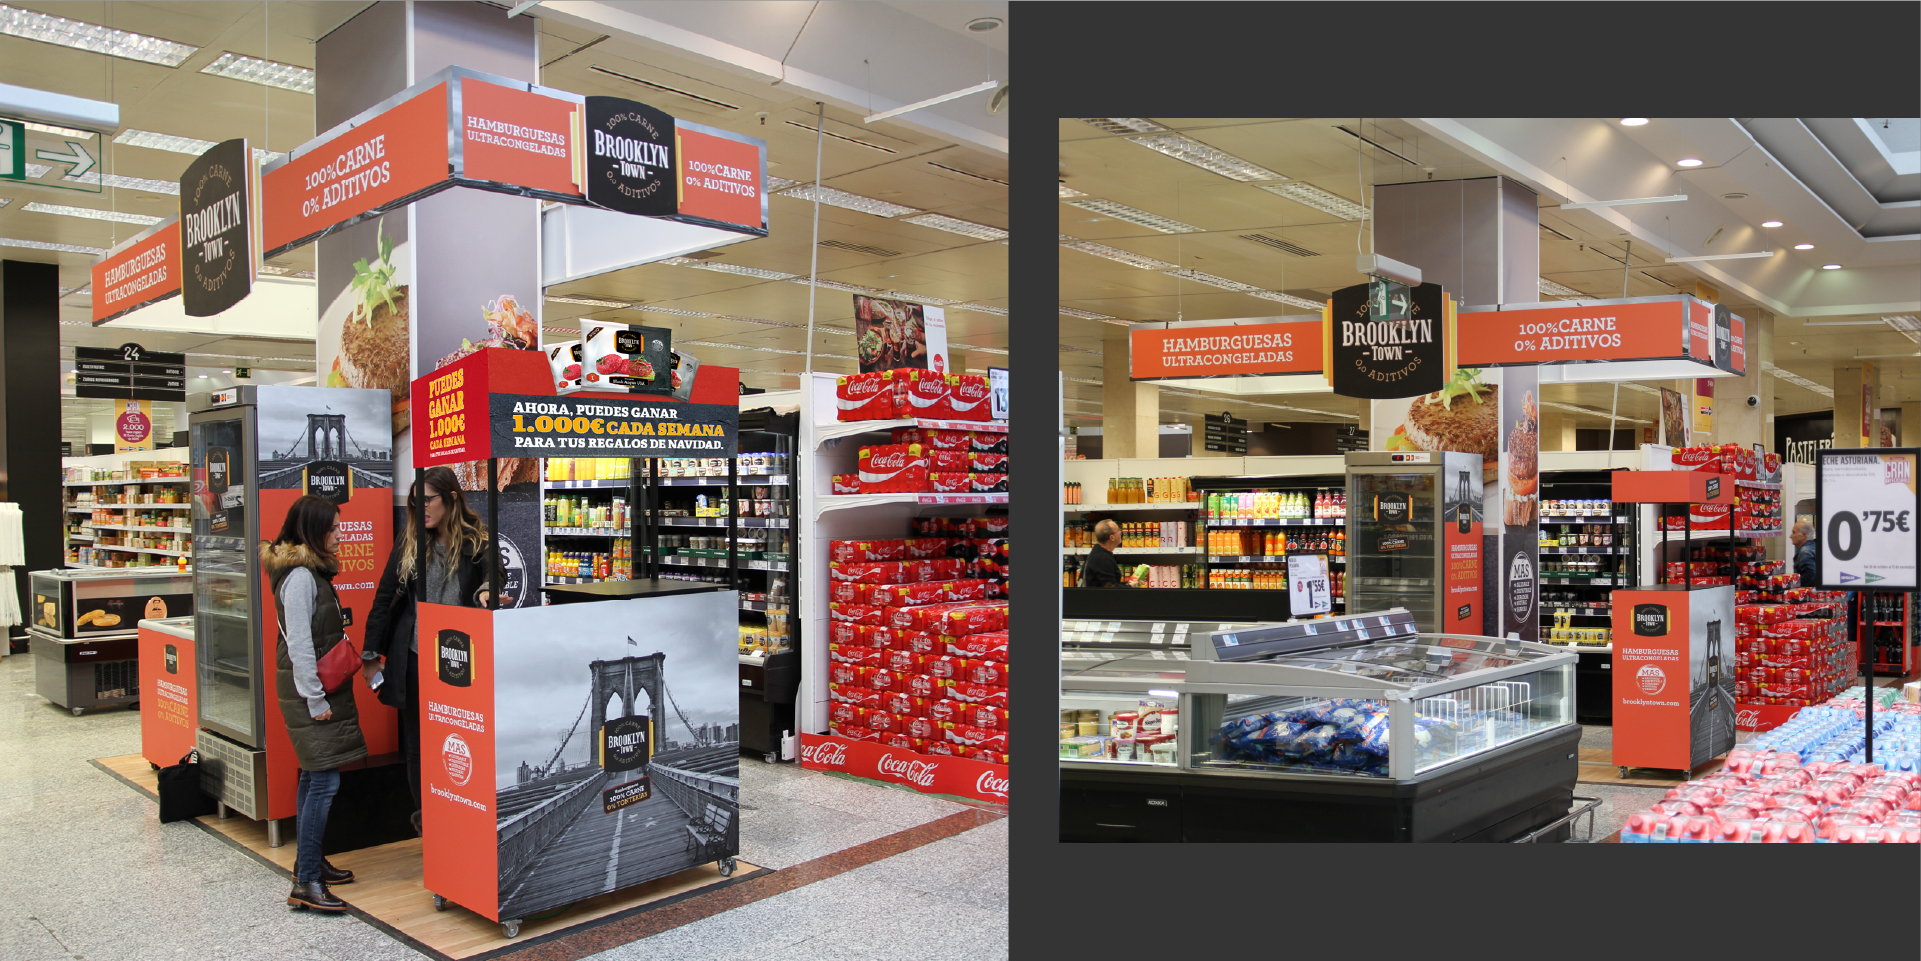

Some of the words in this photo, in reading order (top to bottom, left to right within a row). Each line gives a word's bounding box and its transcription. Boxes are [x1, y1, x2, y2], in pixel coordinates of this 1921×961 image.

[467, 116, 565, 146] HAMBURGUESAS
[629, 112, 659, 139] CARNE
[467, 130, 566, 158] ULTRACONGELADAS
[594, 129, 669, 169] BROOKLYN
[209, 164, 232, 188] CARNE
[620, 161, 646, 179] TOWN
[303, 196, 319, 217] 0%
[322, 161, 390, 209] ADITIVOS
[618, 179, 660, 198] ADITIVOS
[686, 175, 701, 187] 0%
[703, 177, 755, 198] ADITIVOS
[186, 191, 240, 248] BROOKLYN
[203, 237, 223, 263] TOWN
[105, 243, 166, 288] HAMBURGUESAS
[202, 249, 235, 291] ADITIVOS
[105, 266, 167, 304] ULTRACONGELADAS
[1163, 333, 1292, 352] HAMBURGUESAS
[1342, 319, 1432, 346] BROOKLYN
[1514, 340, 1536, 351] 0%
[1540, 333, 1621, 350] ADITIVOS
[124, 346, 139, 360] 24
[1162, 351, 1293, 366] ULTRACONGELADAS
[1371, 346, 1402, 360] TOWN
[1368, 357, 1422, 382] ADITIVOS
[429, 368, 463, 398] PUEDES
[429, 391, 464, 419] GANAR
[513, 402, 574, 417] AHORA,
[576, 404, 629, 417] PUEDES
[631, 407, 678, 419] GANAR
[430, 413, 465, 438] 1.000€
[512, 415, 605, 434] 1.000€
[607, 422, 656, 436] CADA
[658, 424, 725, 437] SEMANA
[515, 437, 556, 448] PARA
[557, 437, 586, 448] TUS
[588, 438, 648, 449] REGALOS
[650, 439, 667, 449] DE
[667, 439, 724, 450] NAVIDAD.
[1823, 457, 1838, 465] ECHE
[1840, 456, 1880, 465] ASTURIANA.
[1885, 461, 1910, 478] GRAN
[310, 476, 345, 485] BROOKLYN
[1380, 502, 1406, 510] BROOKLYN
[340, 521, 373, 531] UESAS
[1828, 510, 1910, 561] 0'75€
[333, 582, 375, 591] own.com
[1637, 614, 1664, 622] BROOKLYN
[441, 646, 468, 662] BROOKLYN
[428, 701, 484, 722] HAMBURGUESAS
[1623, 698, 1680, 707] brooklyntown.com
[428, 712, 485, 732] ULTRACONGELADAS
[608, 731, 645, 748] BROOKLYN
[877, 753, 939, 786] Coca-Cola
[430, 783, 486, 811] brooklyntown.com
[609, 792, 625, 802] 100%
[626, 785, 645, 797] CARNE
